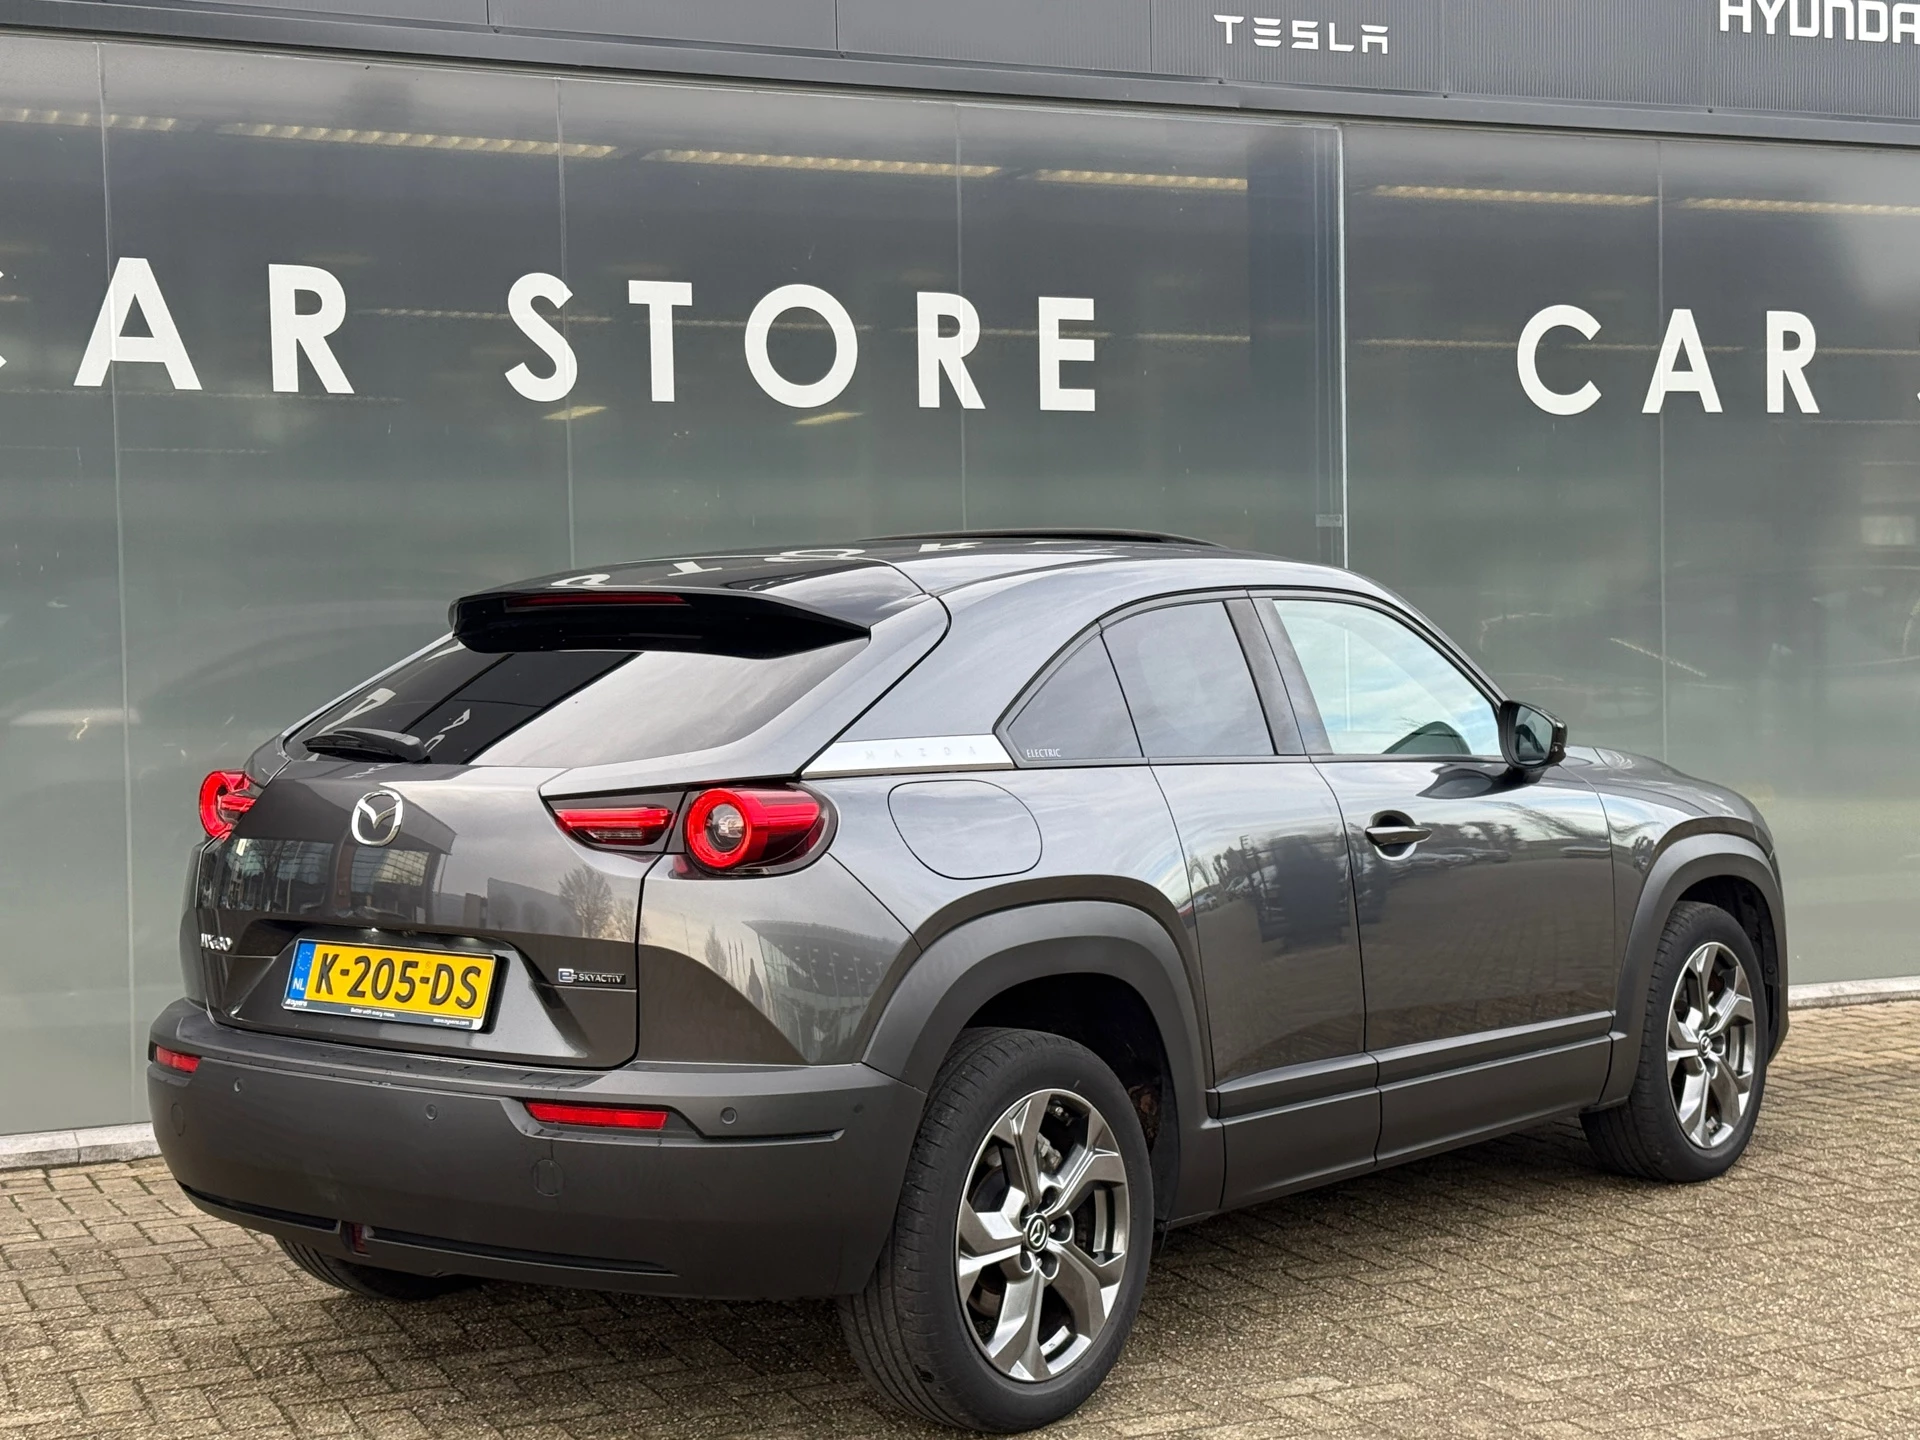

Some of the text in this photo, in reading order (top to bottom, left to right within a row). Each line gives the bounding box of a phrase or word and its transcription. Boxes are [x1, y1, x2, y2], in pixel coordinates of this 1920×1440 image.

[1213, 14, 1389, 55] TESLA
[0, 257, 1098, 413] AR STORE
[1517, 304, 1820, 416] CAR
[1026, 748, 1061, 758] ELECTRIC
[292, 977, 305, 991] NL
[315, 952, 481, 1009] K-205-DS
